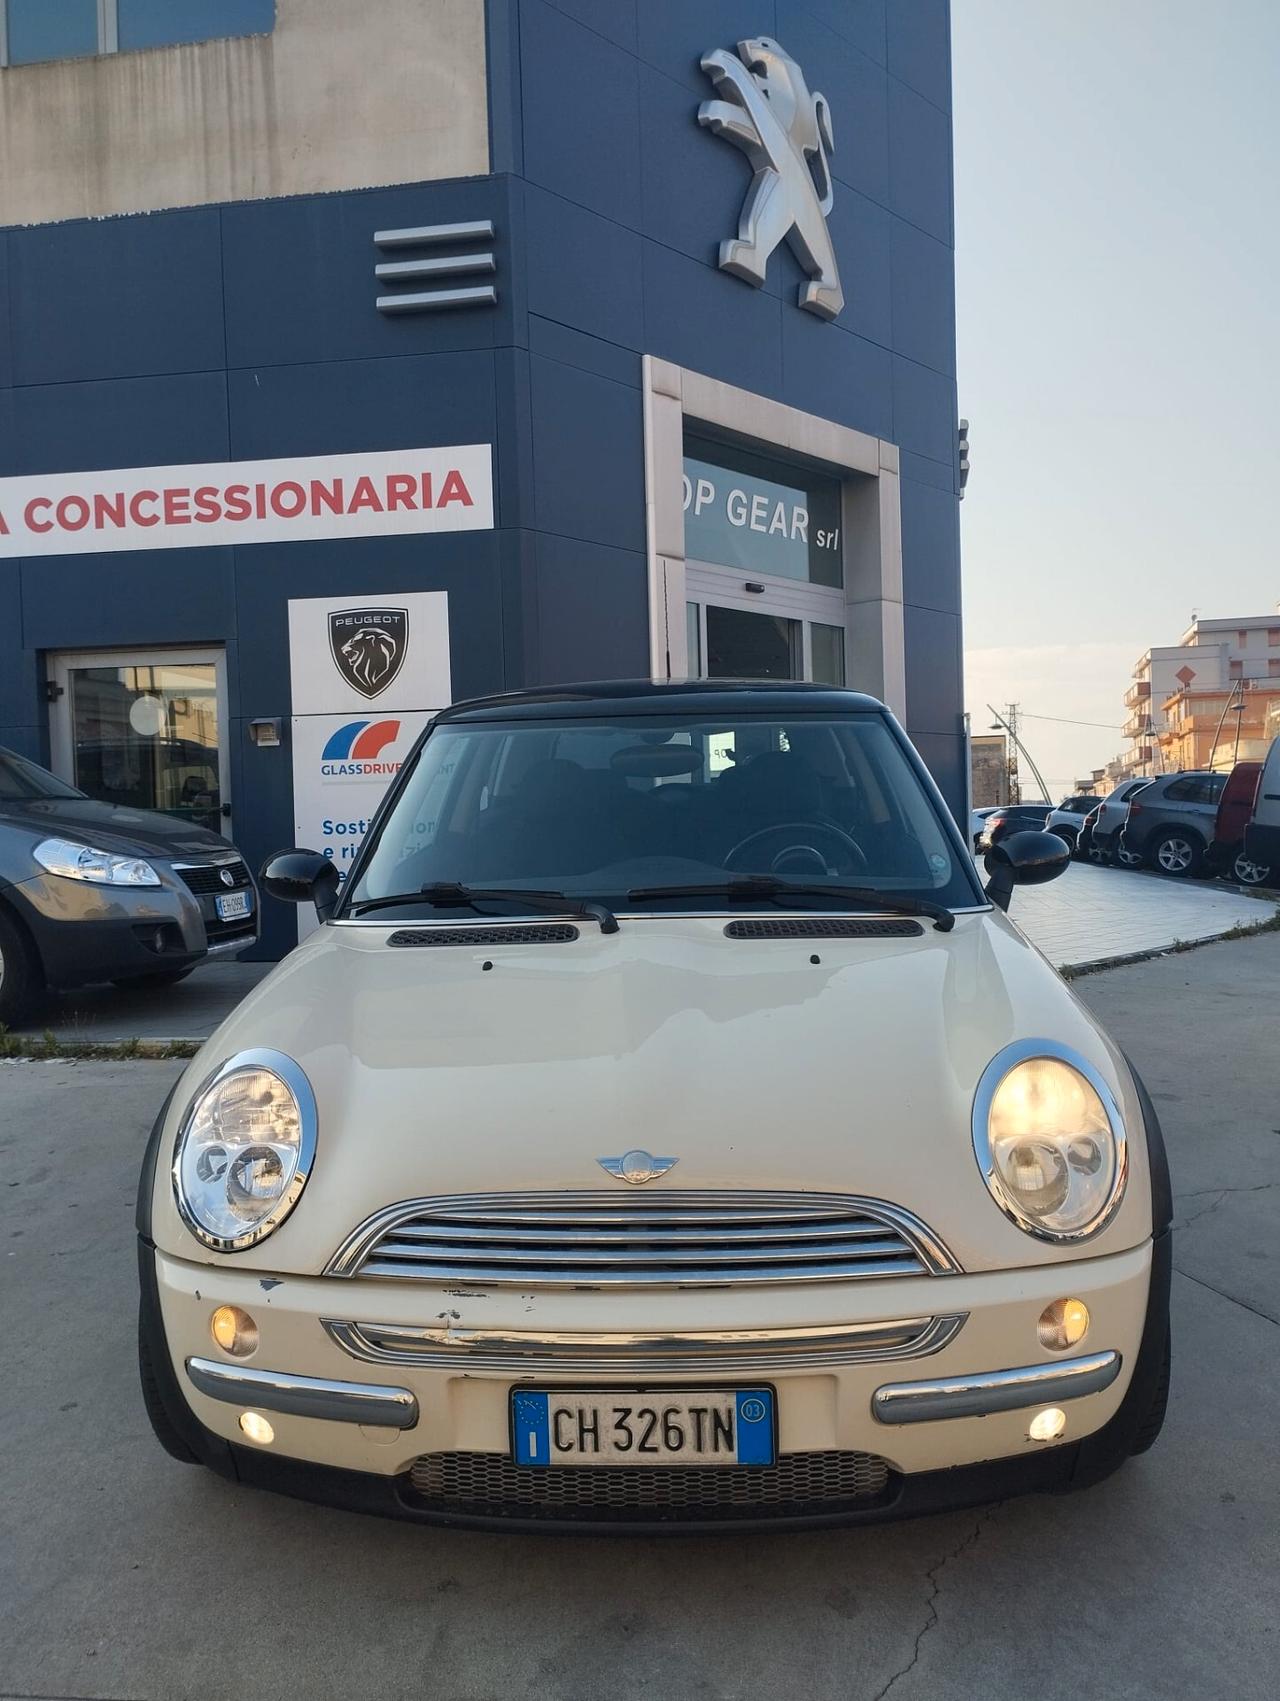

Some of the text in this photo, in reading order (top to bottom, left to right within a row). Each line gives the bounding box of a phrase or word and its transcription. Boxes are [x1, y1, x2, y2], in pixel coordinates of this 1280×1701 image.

[24, 470, 474, 533] CONCESSIONARIA
[727, 488, 809, 543] GEAR
[816, 529, 839, 551] srl
[335, 615, 400, 627] PEUGEOT
[553, 1407, 599, 1452] CH
[612, 1407, 735, 1452] 326TN
[745, 1404, 760, 1417] 03
